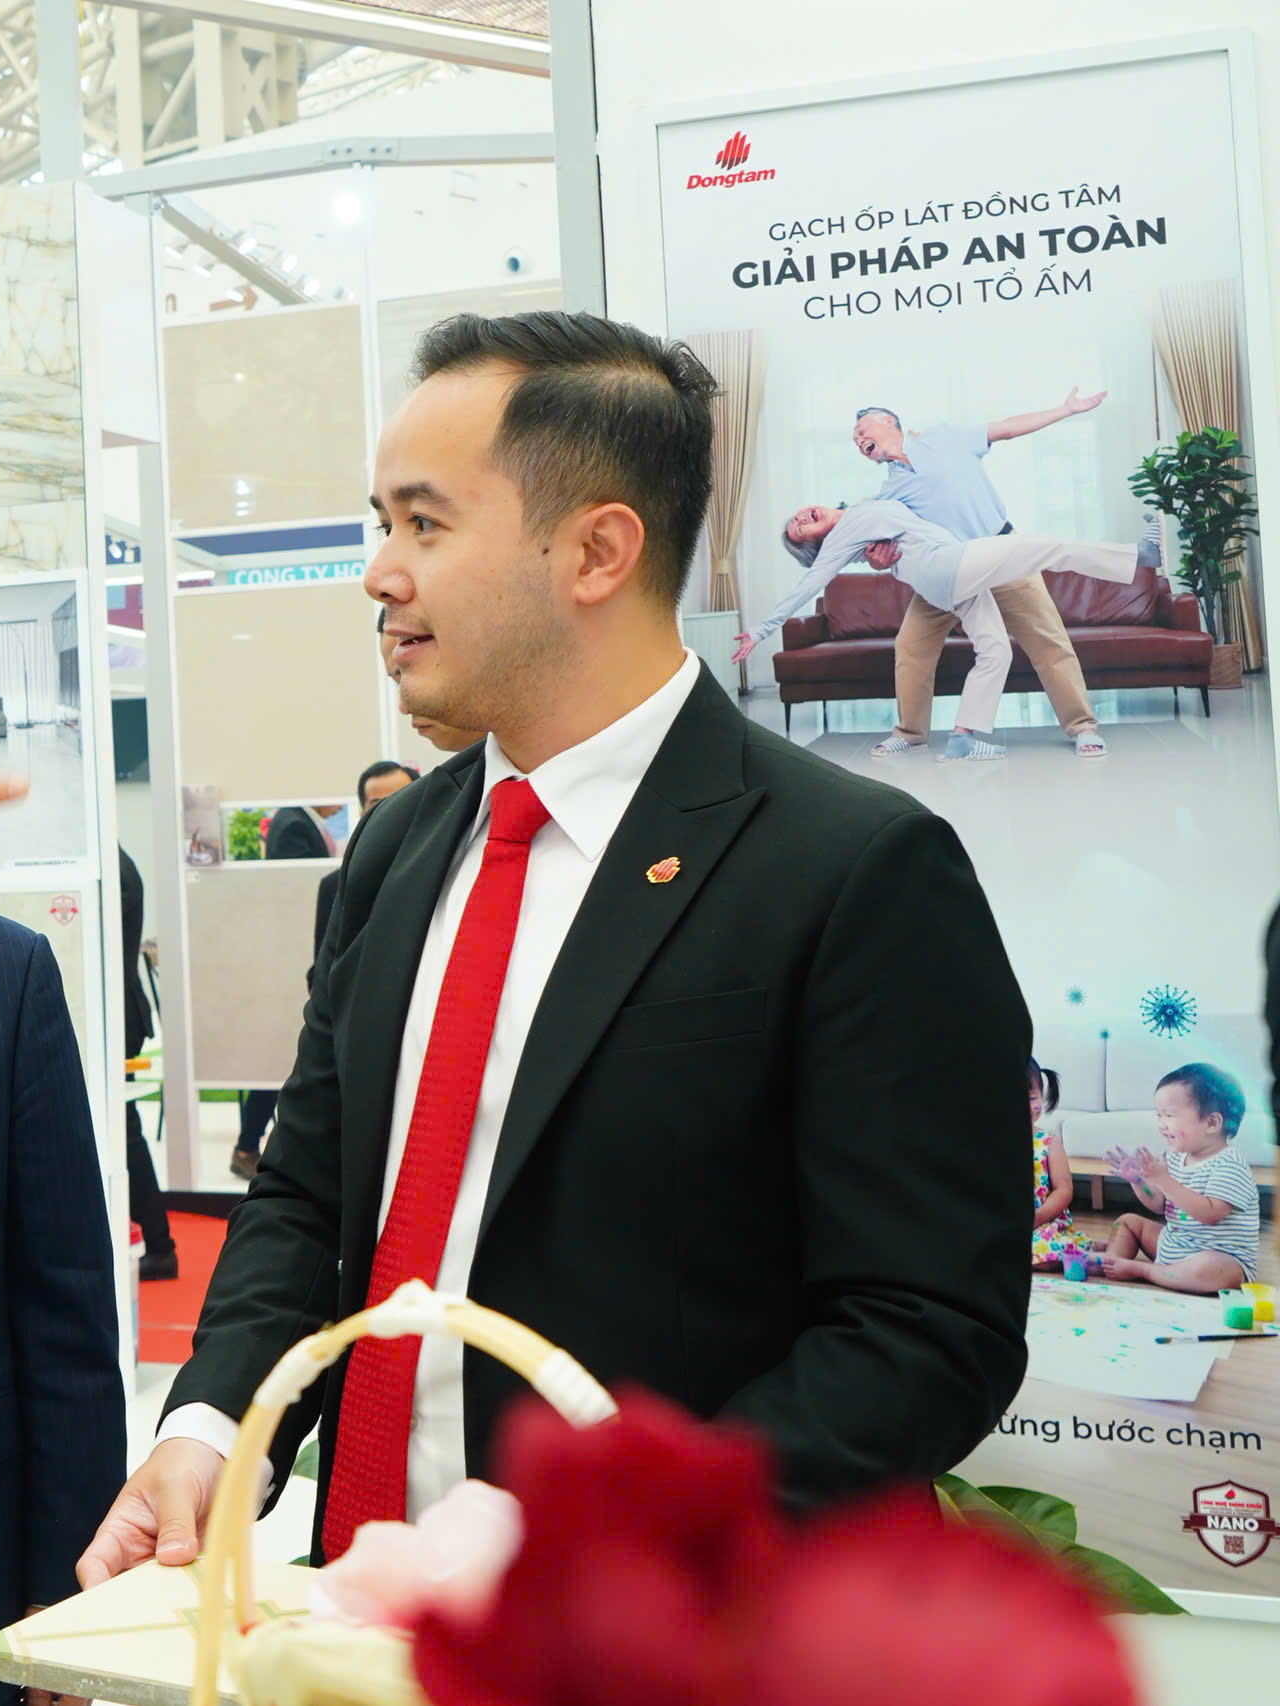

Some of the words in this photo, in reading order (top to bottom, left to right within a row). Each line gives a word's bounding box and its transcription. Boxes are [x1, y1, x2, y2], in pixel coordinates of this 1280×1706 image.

[686, 168, 776, 190] Dongtam
[769, 216, 845, 244] GẠCH
[855, 205, 894, 231] ỐP
[905, 200, 954, 227] LÁT
[962, 191, 1050, 220] ĐỒNG
[1058, 183, 1121, 208] TÂM
[732, 247, 816, 289] GIẢI
[830, 236, 949, 279] PHÁP
[962, 232, 1025, 265] AN
[1038, 214, 1167, 256] TOÀN
[804, 291, 882, 320] CHO
[894, 282, 962, 314] MỌI
[973, 267, 1023, 302] TỔ
[1034, 263, 1092, 298] ẤM
[990, 1411, 1061, 1443] ừng
[1073, 1415, 1155, 1443] bước
[1166, 1422, 1262, 1454] chạm
[1207, 1515, 1259, 1532] NANO
